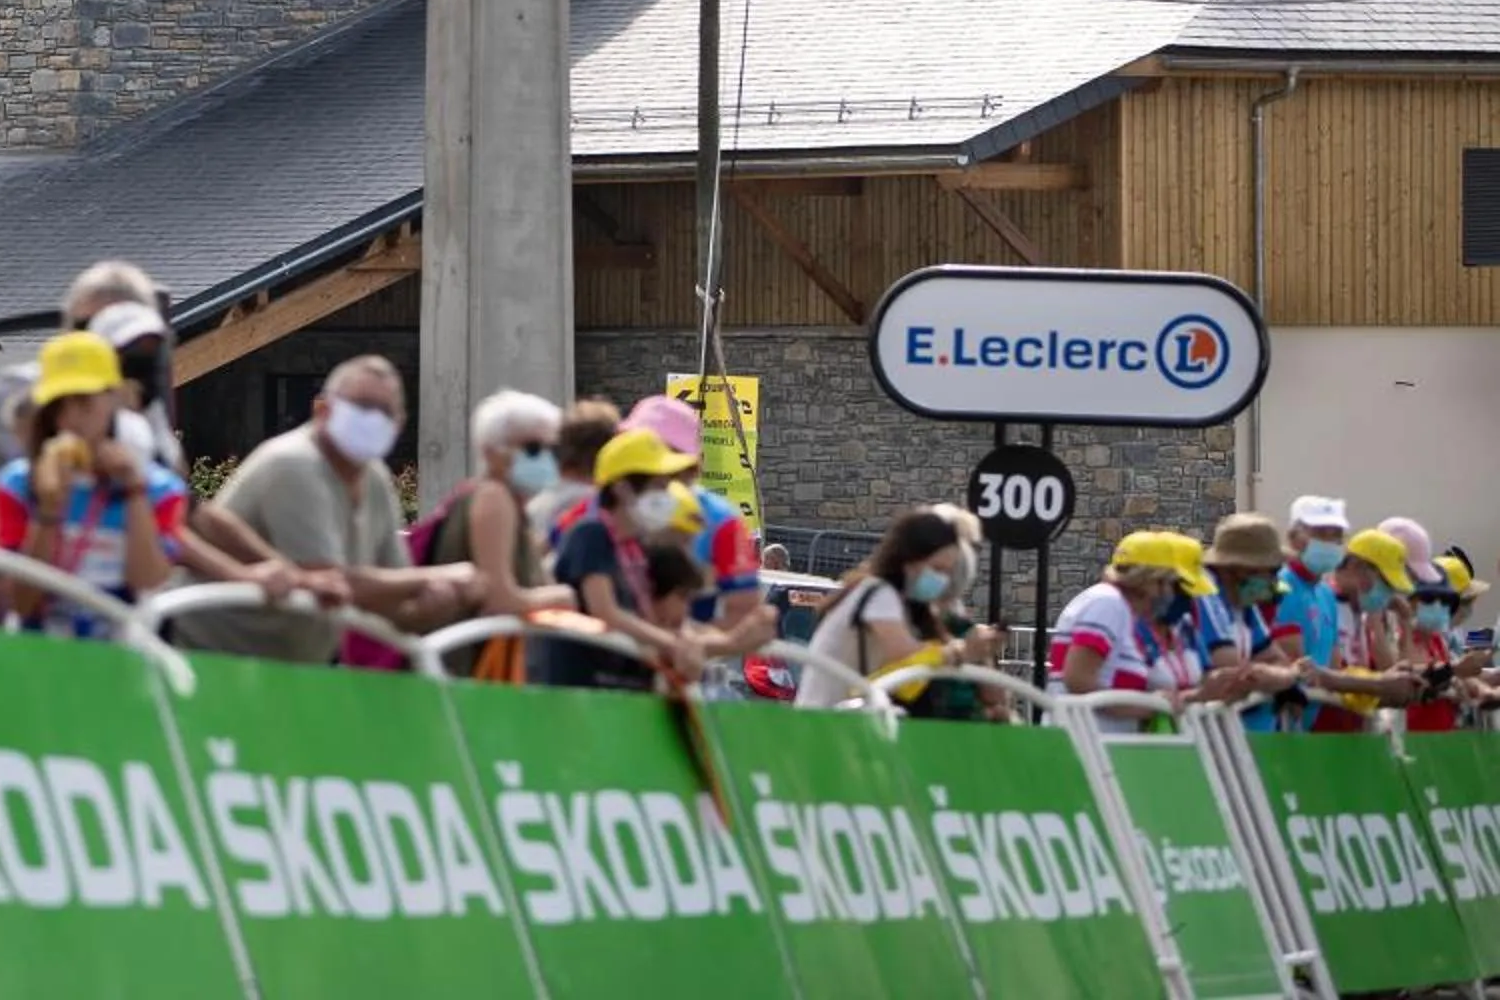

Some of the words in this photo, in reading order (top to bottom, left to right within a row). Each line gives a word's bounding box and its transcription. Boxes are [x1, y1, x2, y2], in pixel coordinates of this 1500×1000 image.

[906, 326, 1149, 372] E.Leclerc
[977, 472, 1063, 521] 300
[206, 737, 502, 920] ŠKODA
[495, 761, 763, 924] ŠKODA
[752, 774, 946, 924] ŠKODA
[929, 786, 1134, 920] ŠKODA
[1283, 791, 1448, 914] ŠKODA
